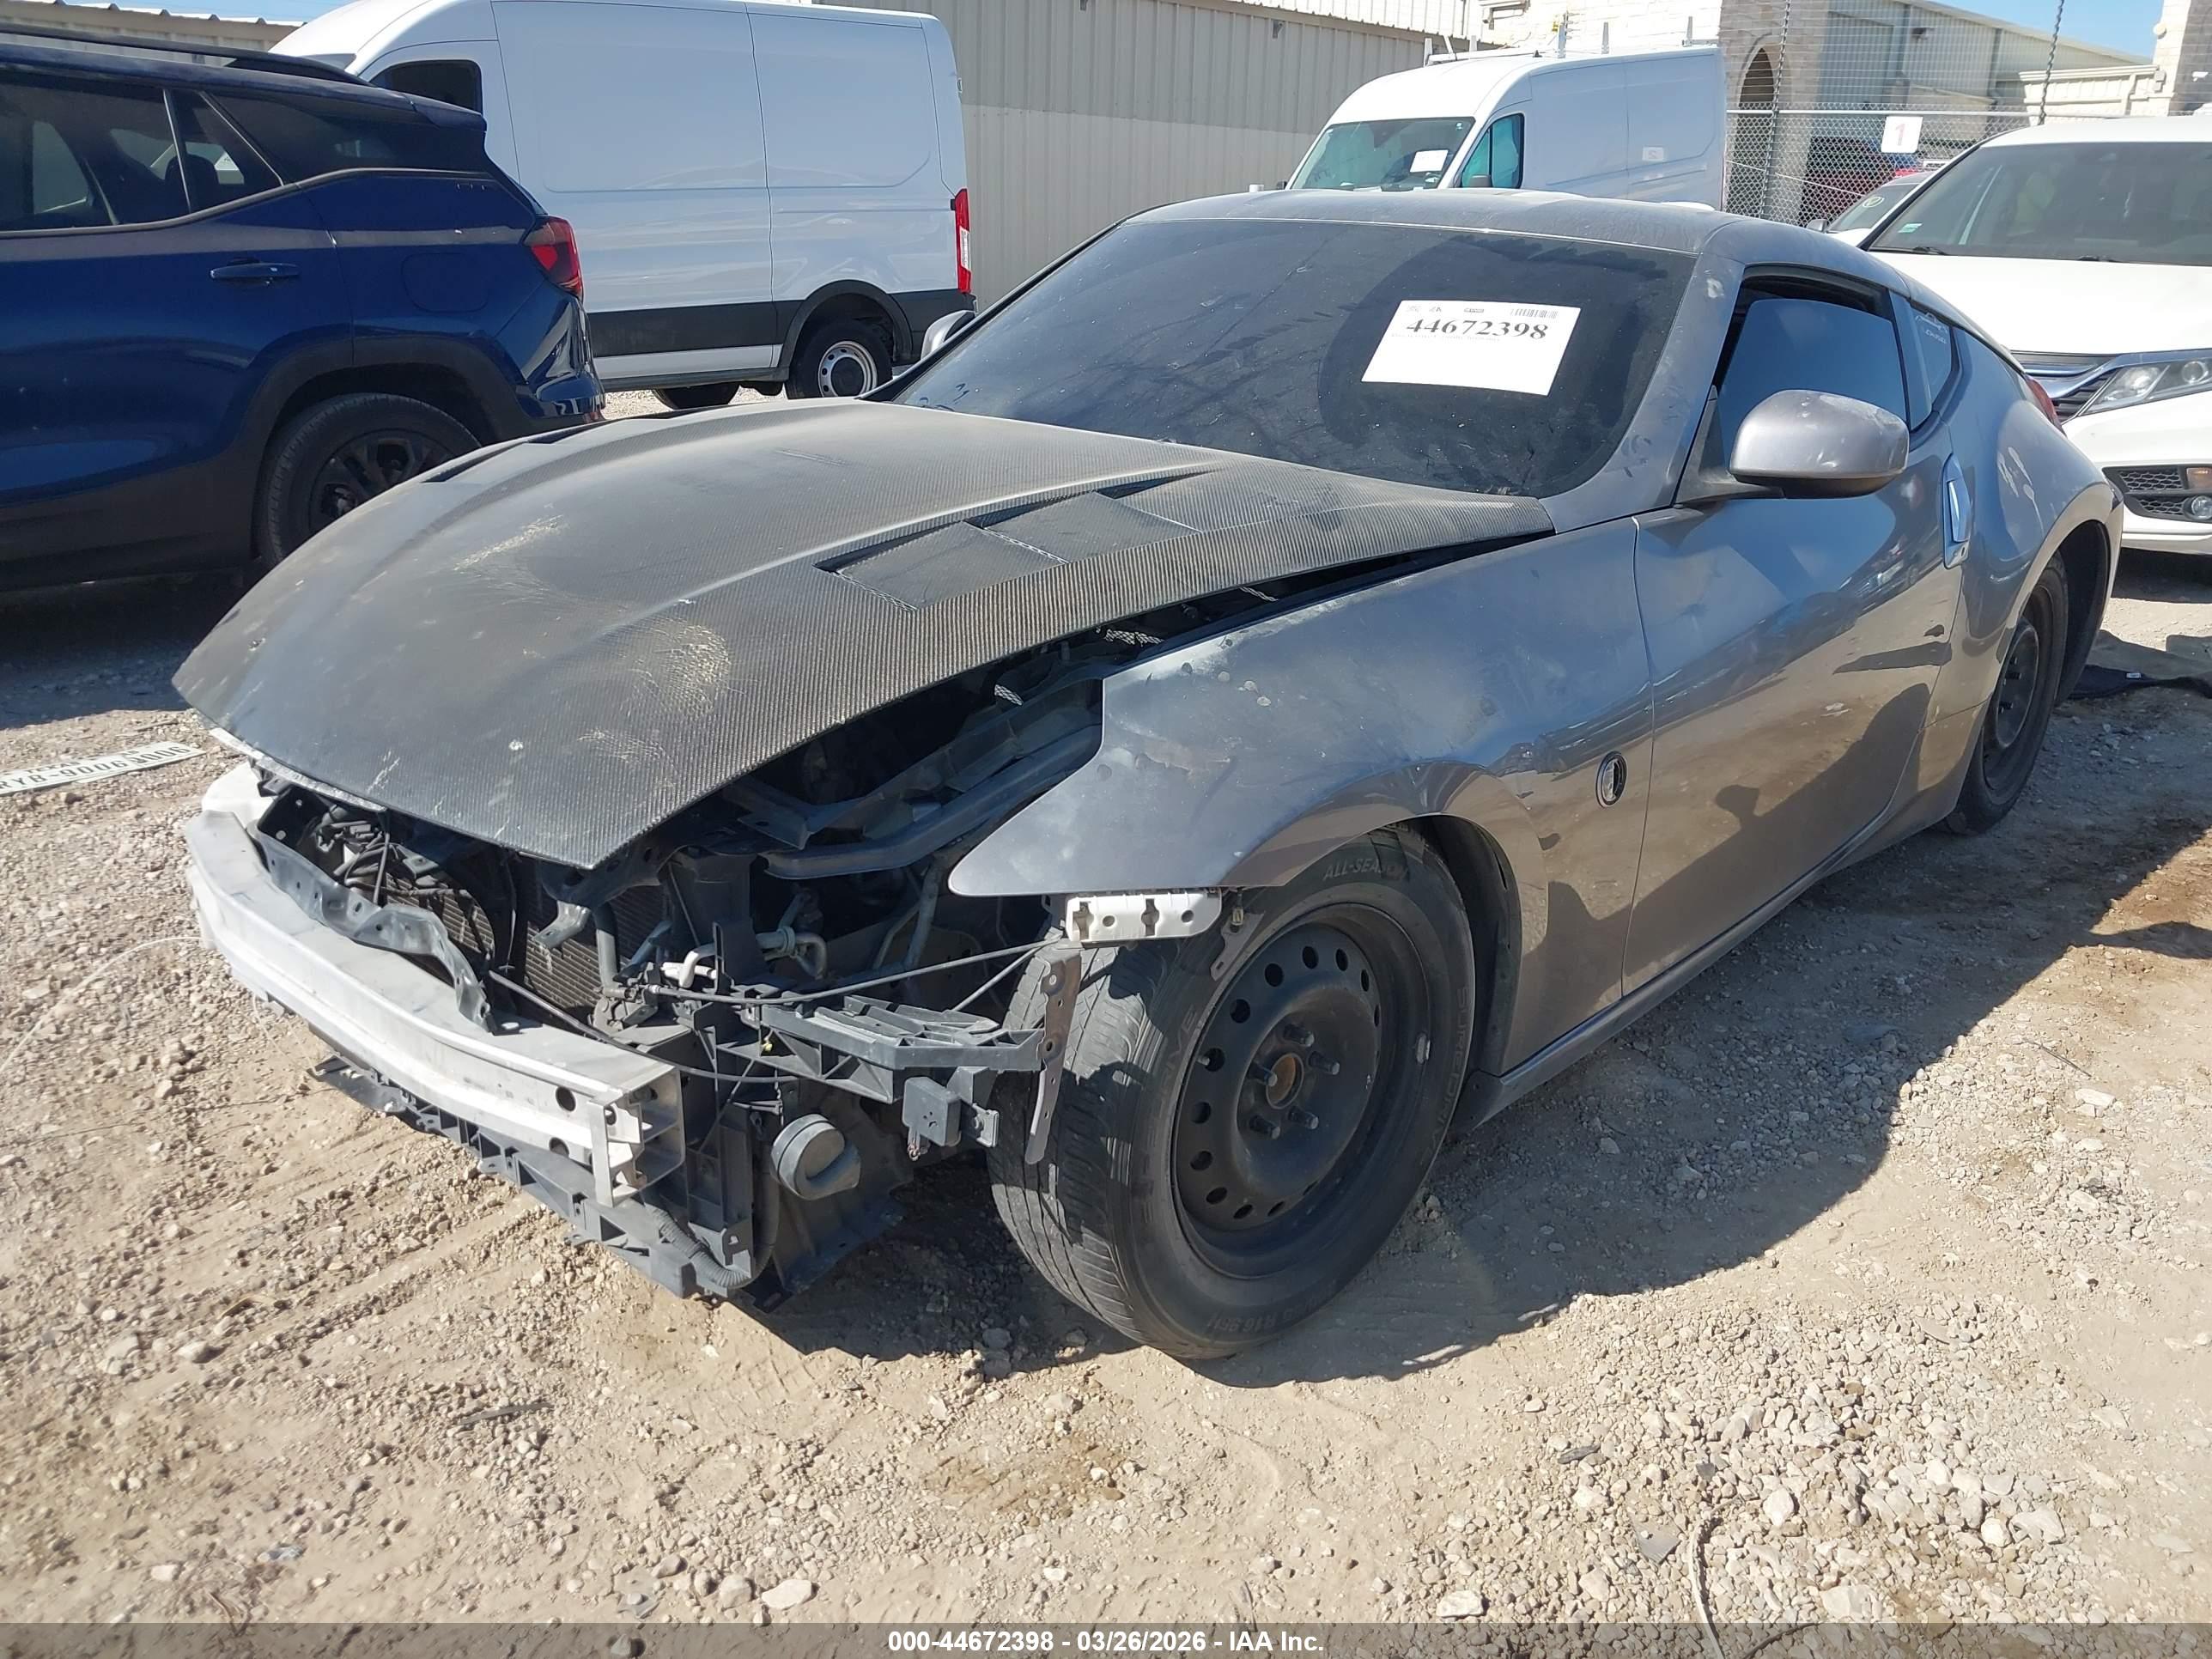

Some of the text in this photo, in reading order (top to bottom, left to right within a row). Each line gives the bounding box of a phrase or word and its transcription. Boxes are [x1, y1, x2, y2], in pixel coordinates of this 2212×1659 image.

[1895, 123, 1906, 146] 1
[1407, 318, 1549, 340] 44672398
[0, 760, 128, 789] RYB-9006
